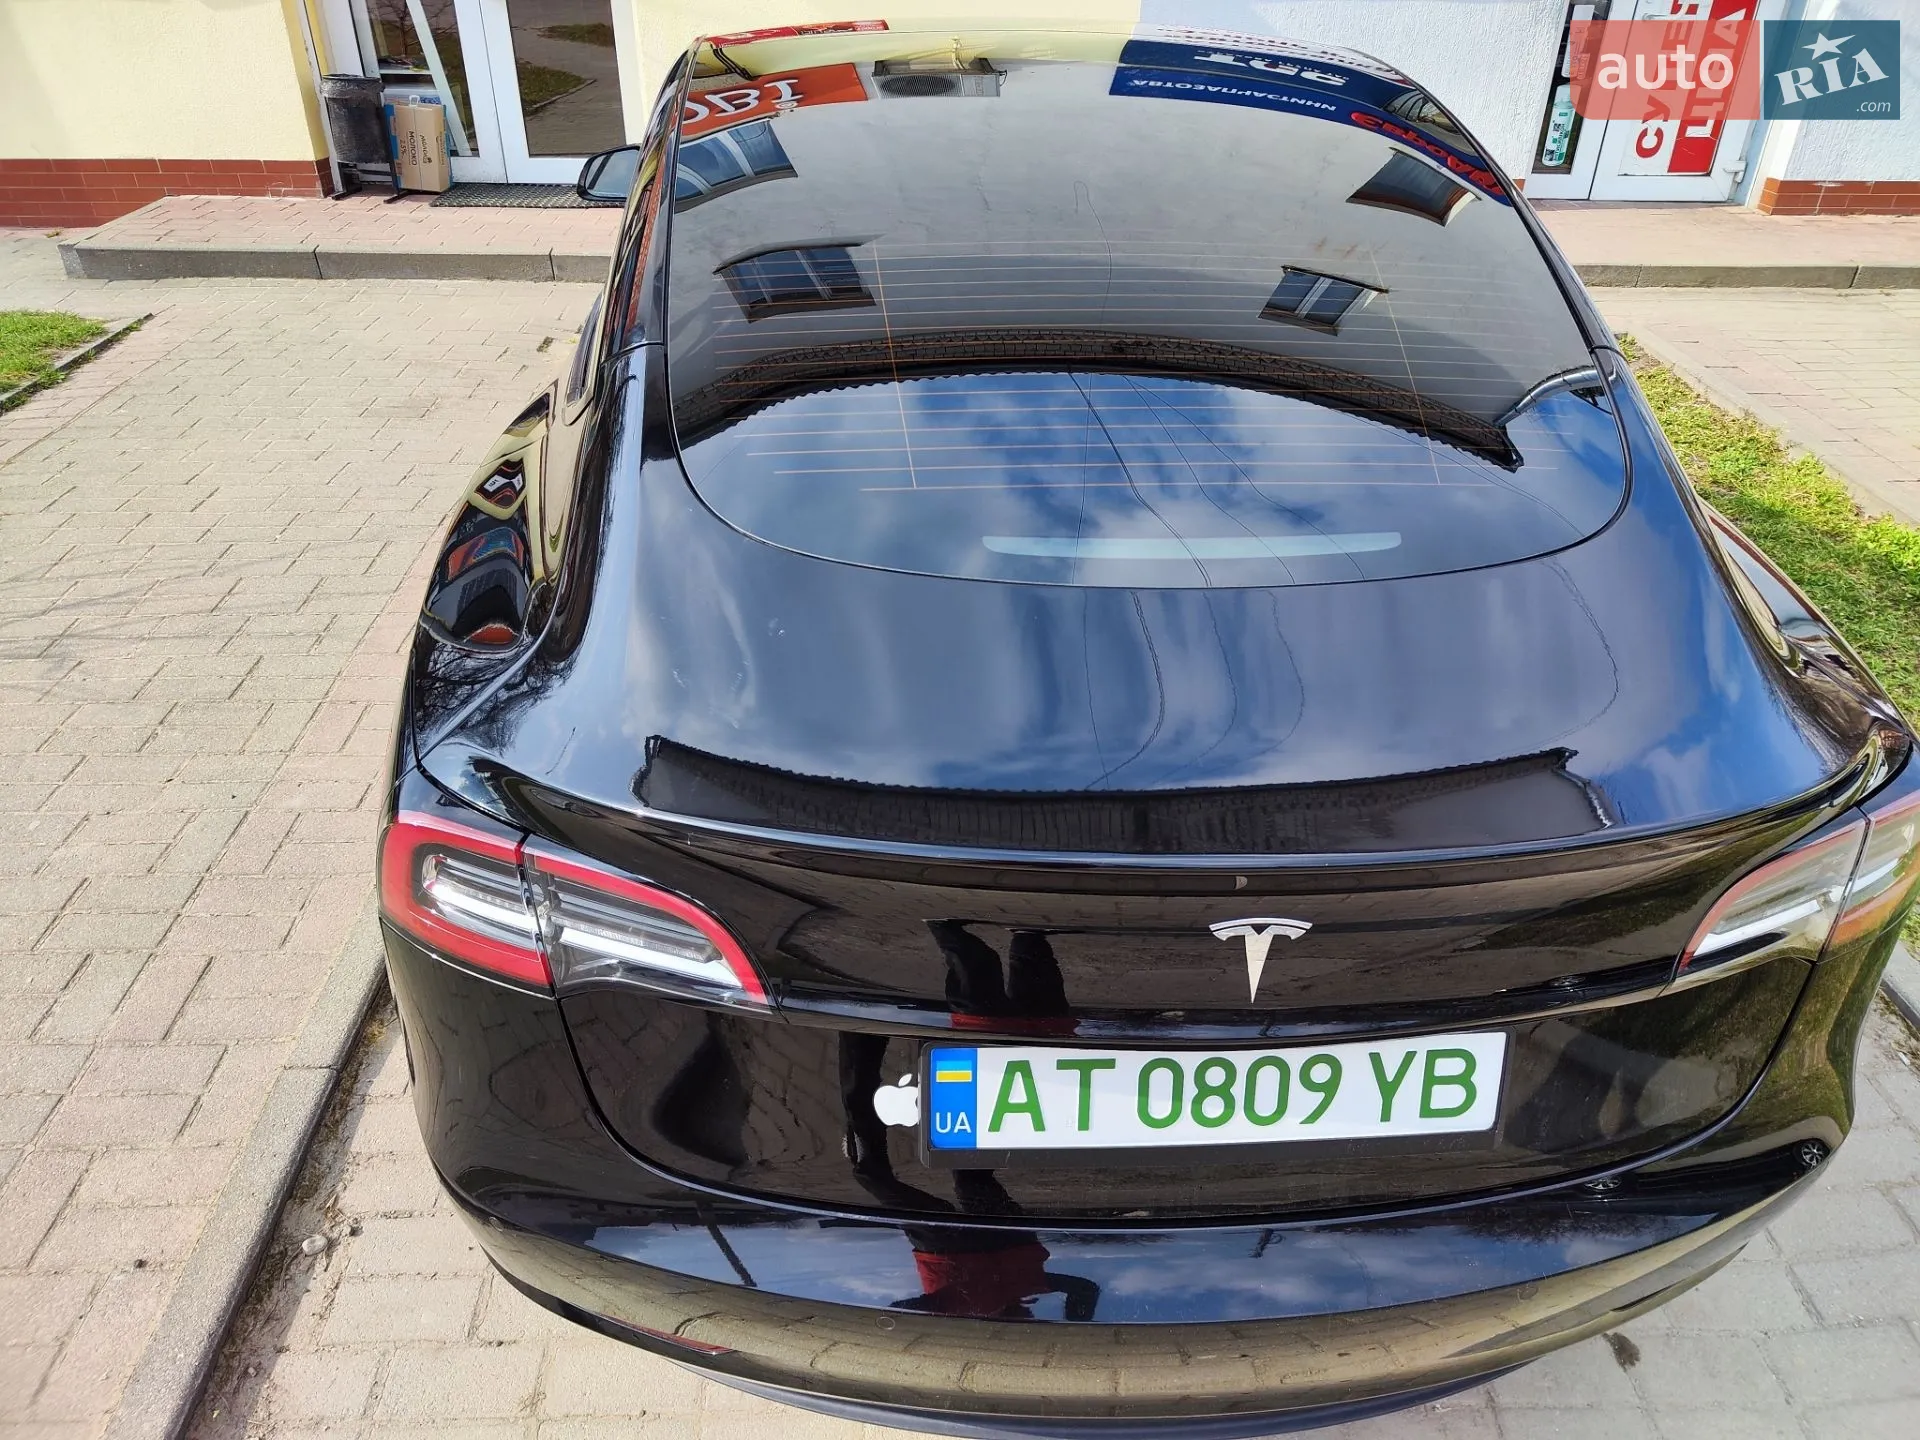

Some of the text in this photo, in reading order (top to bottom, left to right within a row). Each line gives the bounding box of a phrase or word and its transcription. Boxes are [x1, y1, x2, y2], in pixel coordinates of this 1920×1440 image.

[408, 130, 418, 166] МОЛОКО
[987, 1048, 1478, 1133] AT 0809 YB
[935, 1112, 972, 1134] UA
